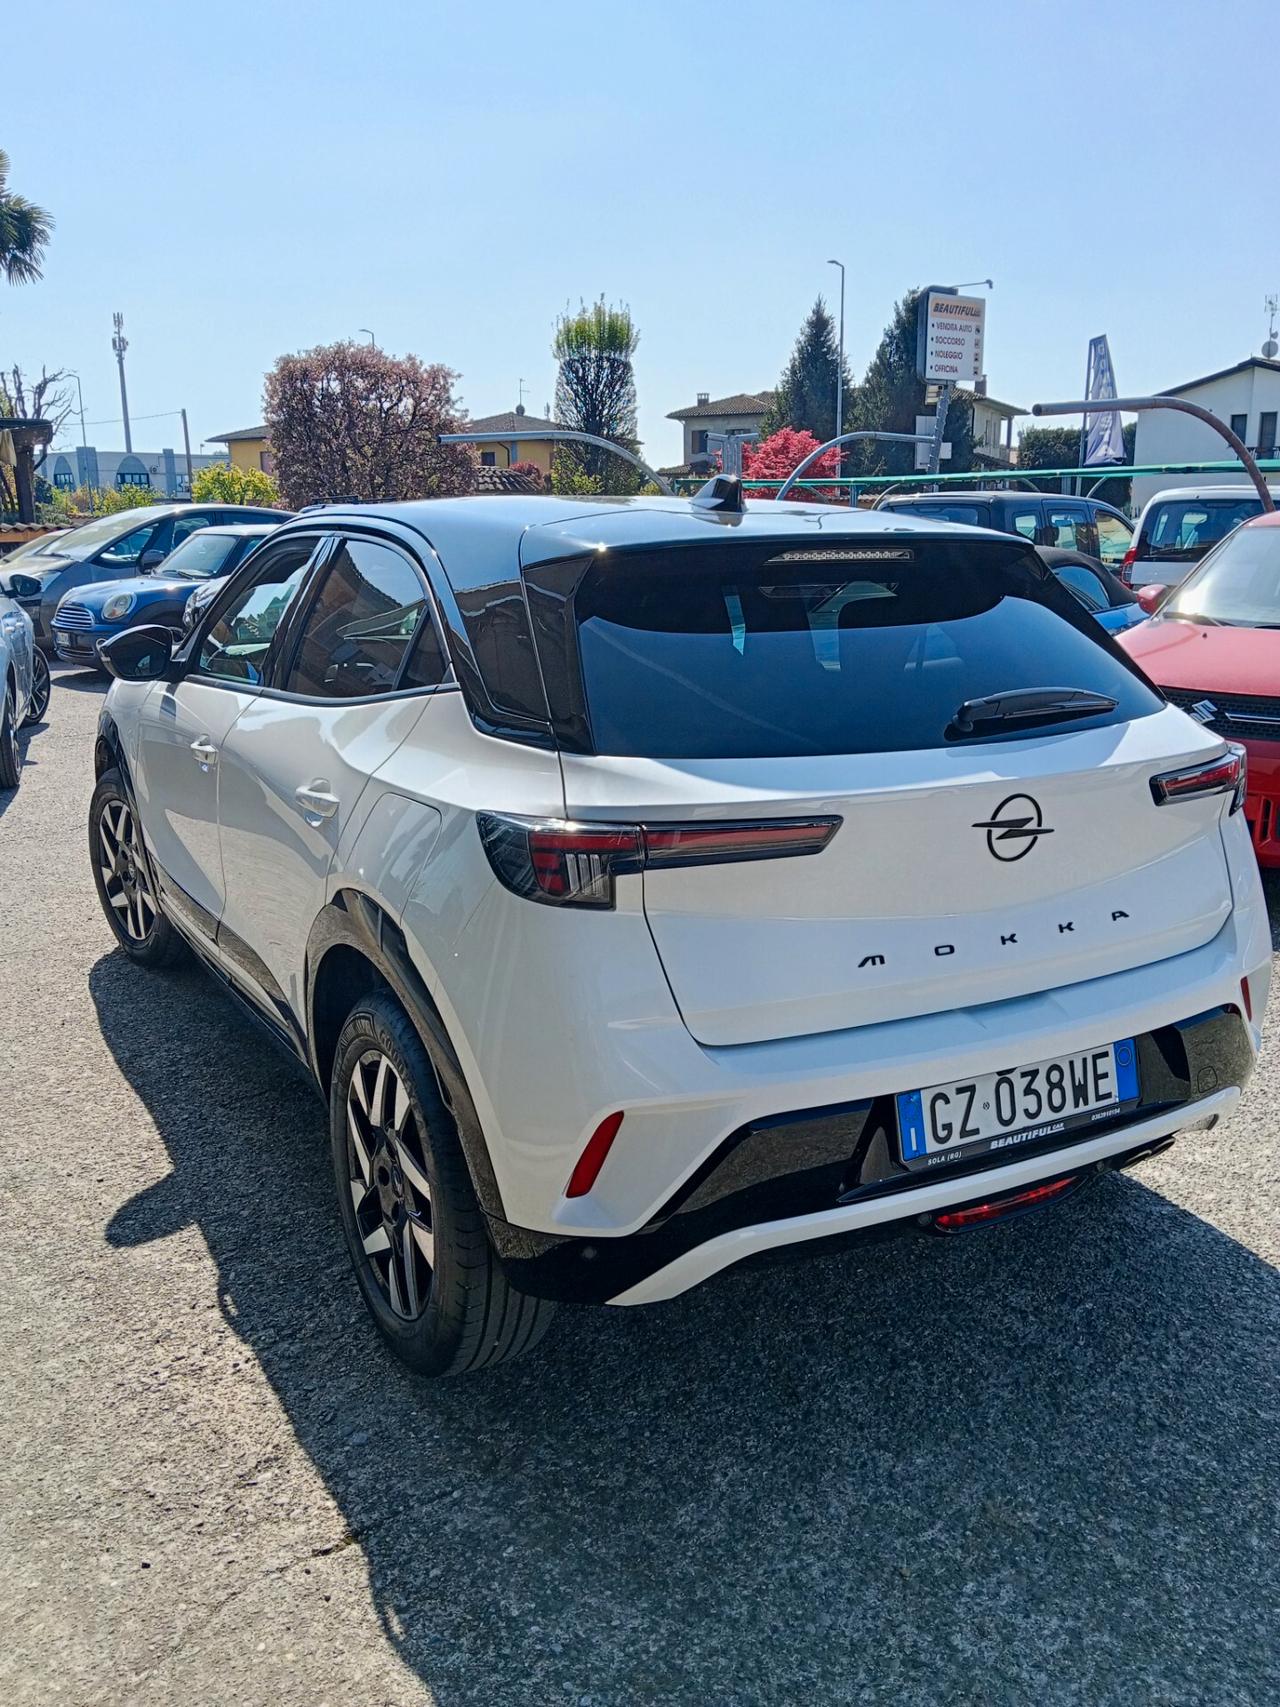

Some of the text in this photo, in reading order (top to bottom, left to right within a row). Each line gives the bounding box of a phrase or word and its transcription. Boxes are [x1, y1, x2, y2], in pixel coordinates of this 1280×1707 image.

[933, 303, 976, 316] BEAUTIFUL
[936, 322, 973, 333] VENDITA AUTO
[935, 335, 965, 346] SOCCORSO
[934, 351, 963, 360] NOLEGGIO
[934, 364, 958, 374] OFFICINA
[990, 1126, 1054, 1150] BEAUTIFUL
